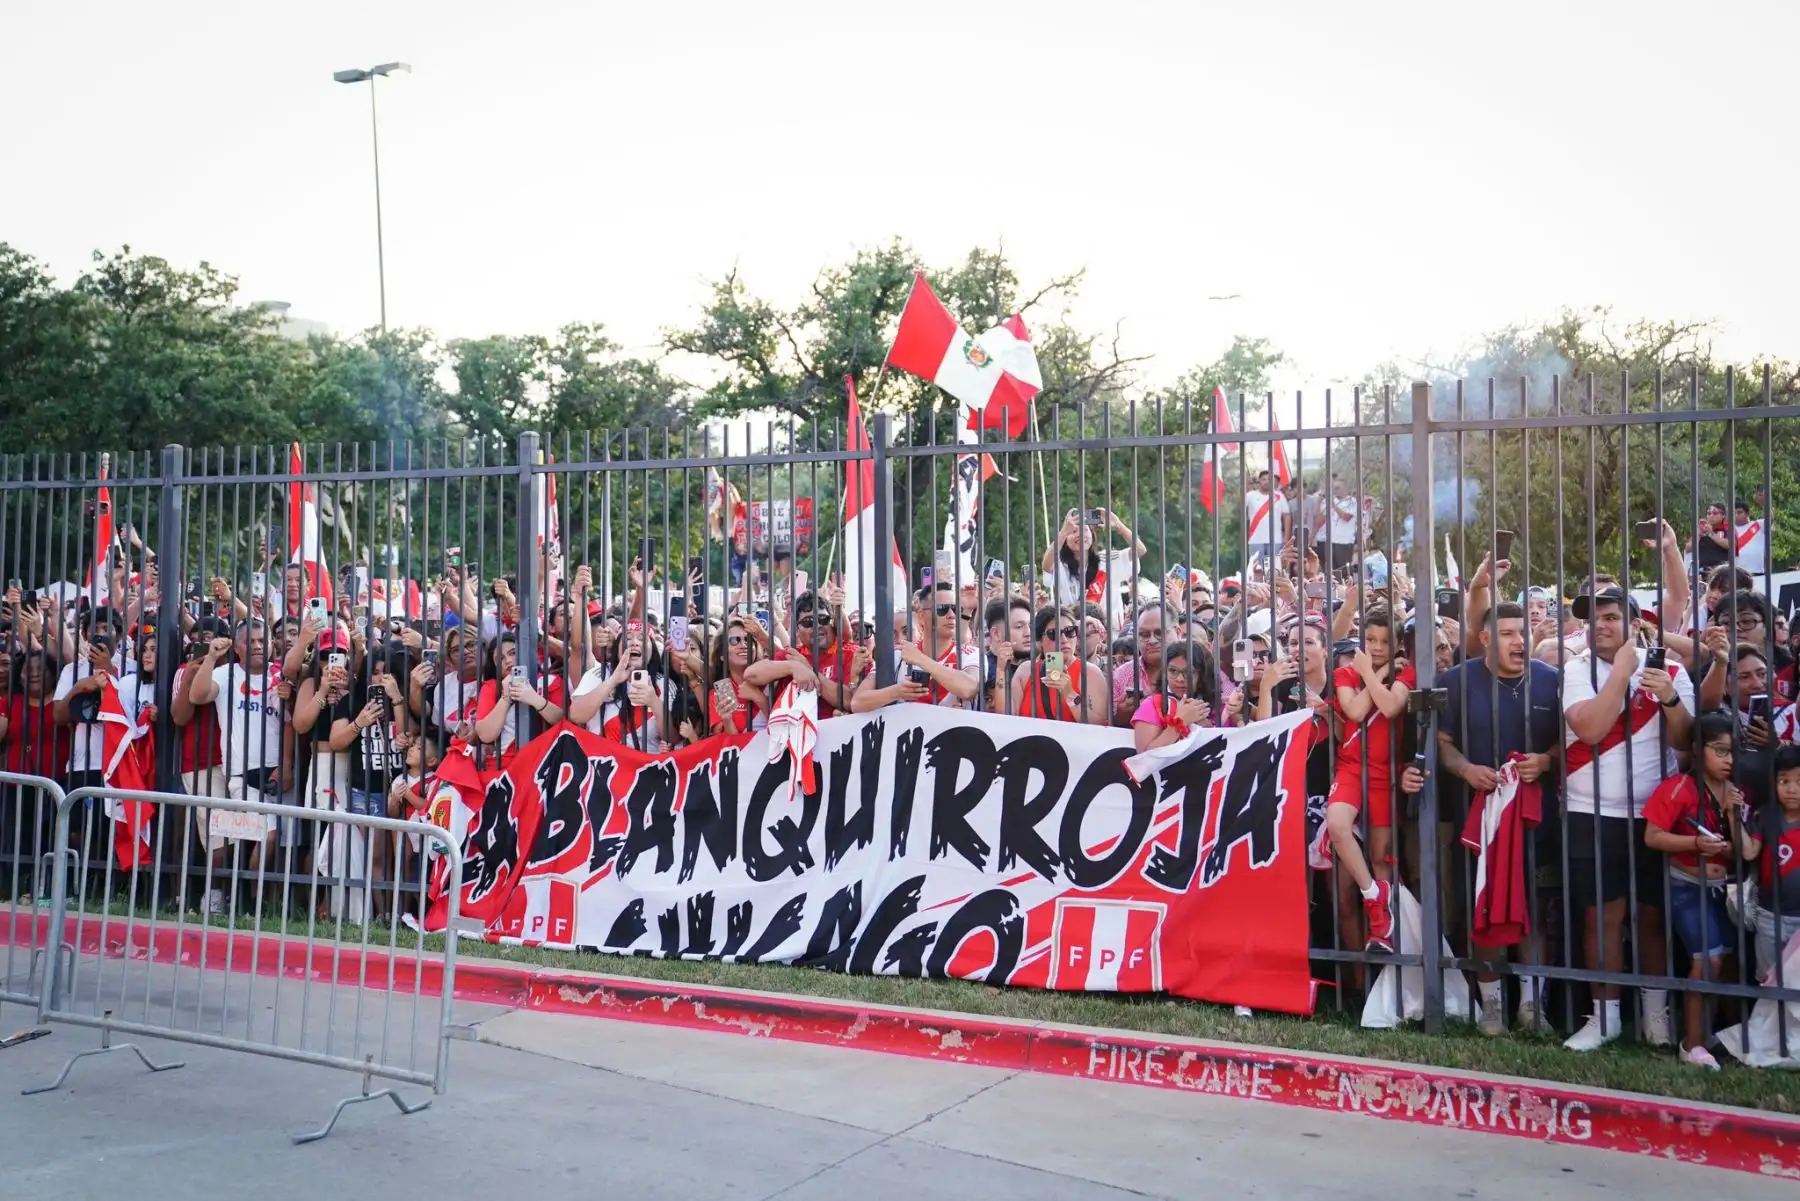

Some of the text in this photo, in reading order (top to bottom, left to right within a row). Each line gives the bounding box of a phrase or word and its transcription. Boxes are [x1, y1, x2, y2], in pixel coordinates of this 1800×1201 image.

[746, 507, 785, 517] OBE
[237, 700, 261, 712] JST
[527, 714, 1290, 895] BLANQUIRROJA
[1778, 844, 1793, 865] 9
[1069, 945, 1144, 970] FPF
[1088, 1040, 1164, 1085] FIRE
[1175, 1052, 1274, 1099] LANE
[1403, 1076, 1592, 1141] PARKING
